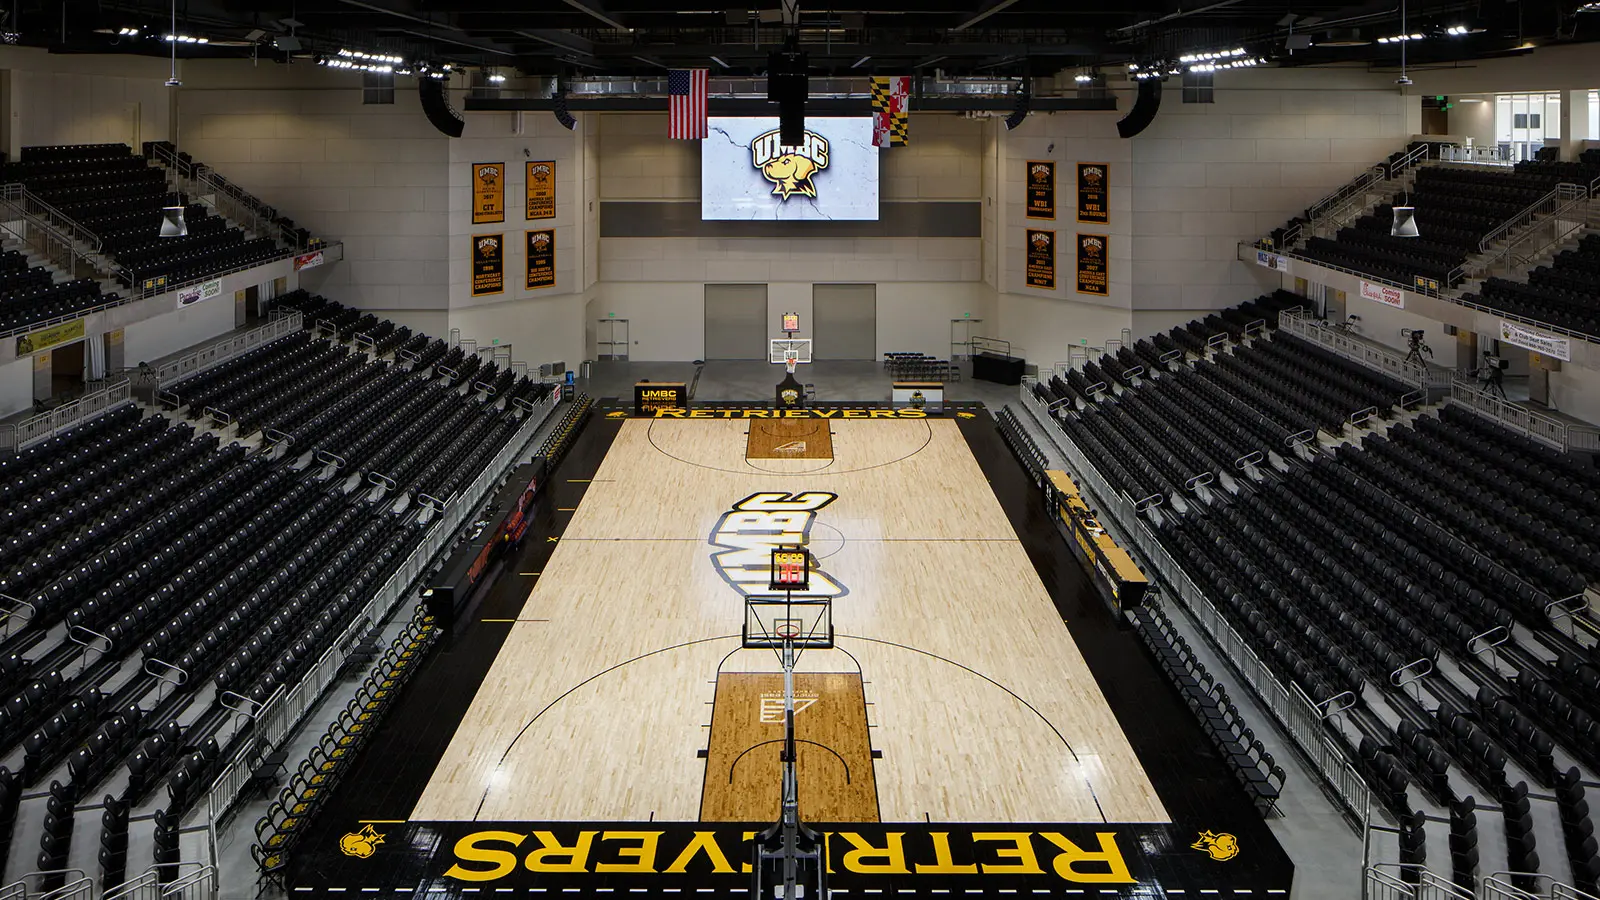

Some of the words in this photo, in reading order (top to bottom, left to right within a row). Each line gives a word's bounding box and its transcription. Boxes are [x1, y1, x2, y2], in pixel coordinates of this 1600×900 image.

[480, 166, 499, 178] UMBC
[532, 164, 550, 175] UMBC
[1032, 165, 1050, 175] UMBC
[1084, 167, 1102, 178] UMBC
[478, 238, 498, 249] UMBC
[532, 233, 550, 244] UMBC
[1032, 234, 1050, 244] UMBC
[1083, 238, 1102, 249] UMBC
[202, 280, 220, 291] Coming
[1382, 288, 1400, 299] Coming
[1384, 296, 1401, 305] SOON!
[781, 390, 798, 398] UMBC
[653, 408, 928, 418] RETRIEVERS
